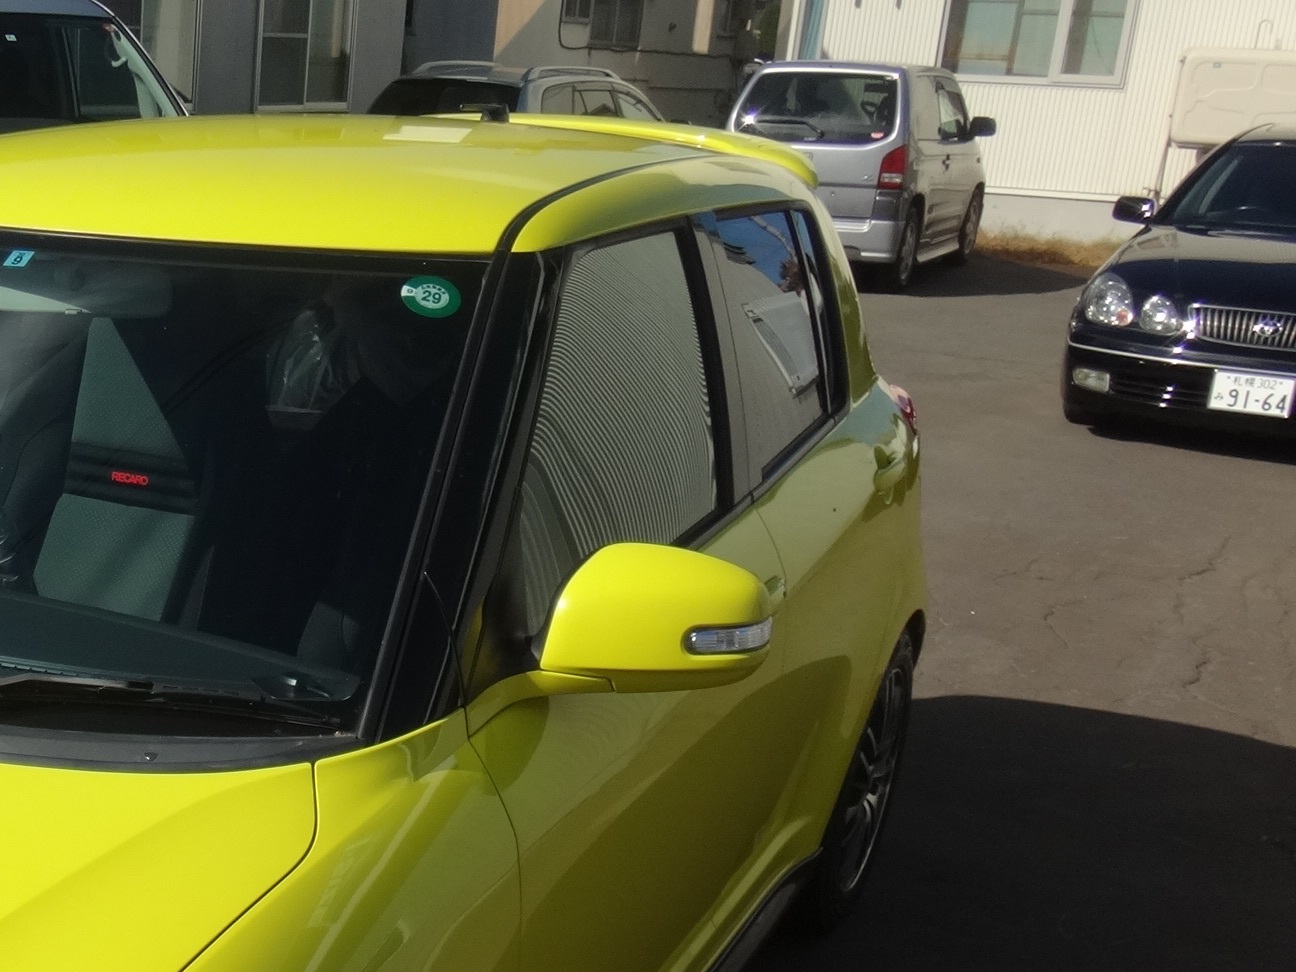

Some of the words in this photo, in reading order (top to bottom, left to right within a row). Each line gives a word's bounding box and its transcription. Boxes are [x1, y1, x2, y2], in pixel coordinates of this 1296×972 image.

[421, 289, 442, 305] 29
[1227, 388, 1287, 414] 91-64
[111, 471, 149, 486] RECARO
